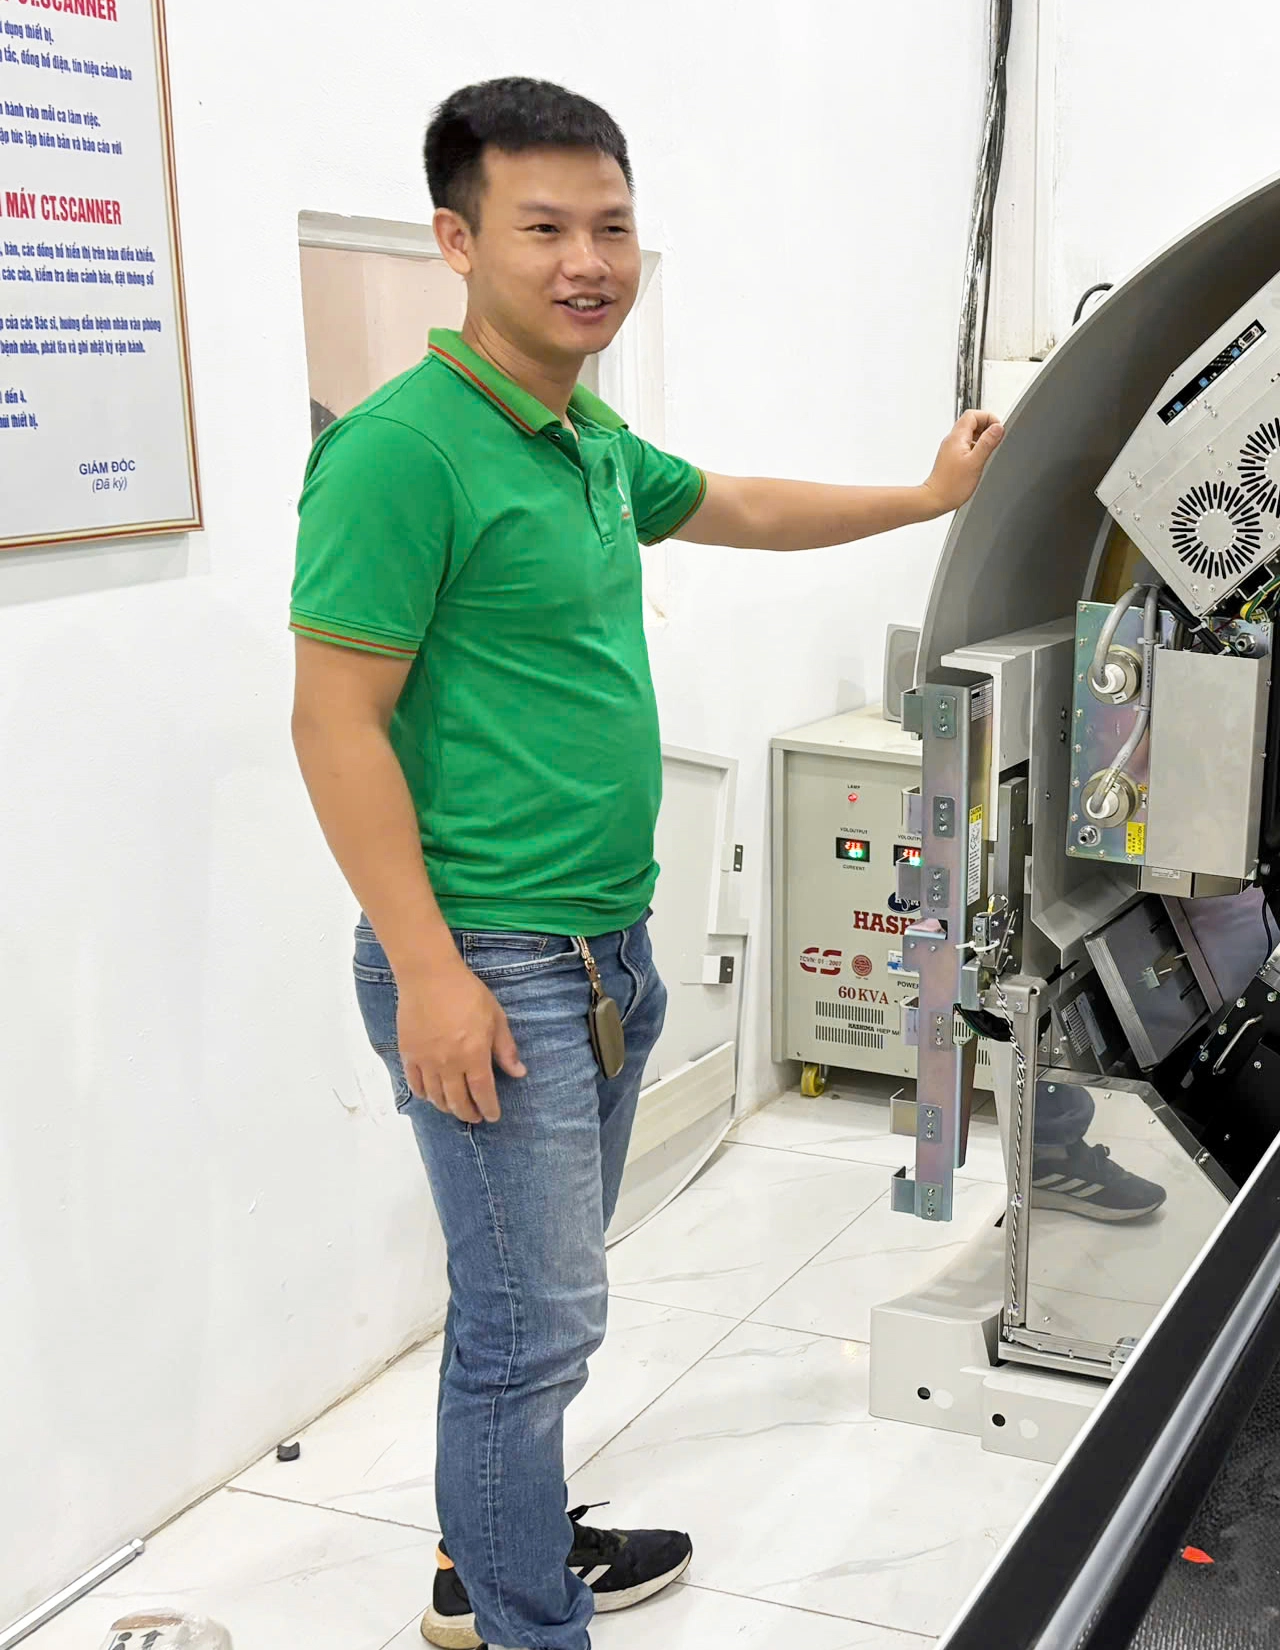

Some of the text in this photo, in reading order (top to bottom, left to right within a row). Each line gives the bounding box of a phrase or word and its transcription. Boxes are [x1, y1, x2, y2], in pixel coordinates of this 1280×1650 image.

[5, 187, 122, 226] MÁY CT.SCANNER
[79, 458, 136, 476] GIÁM ĐỐC
